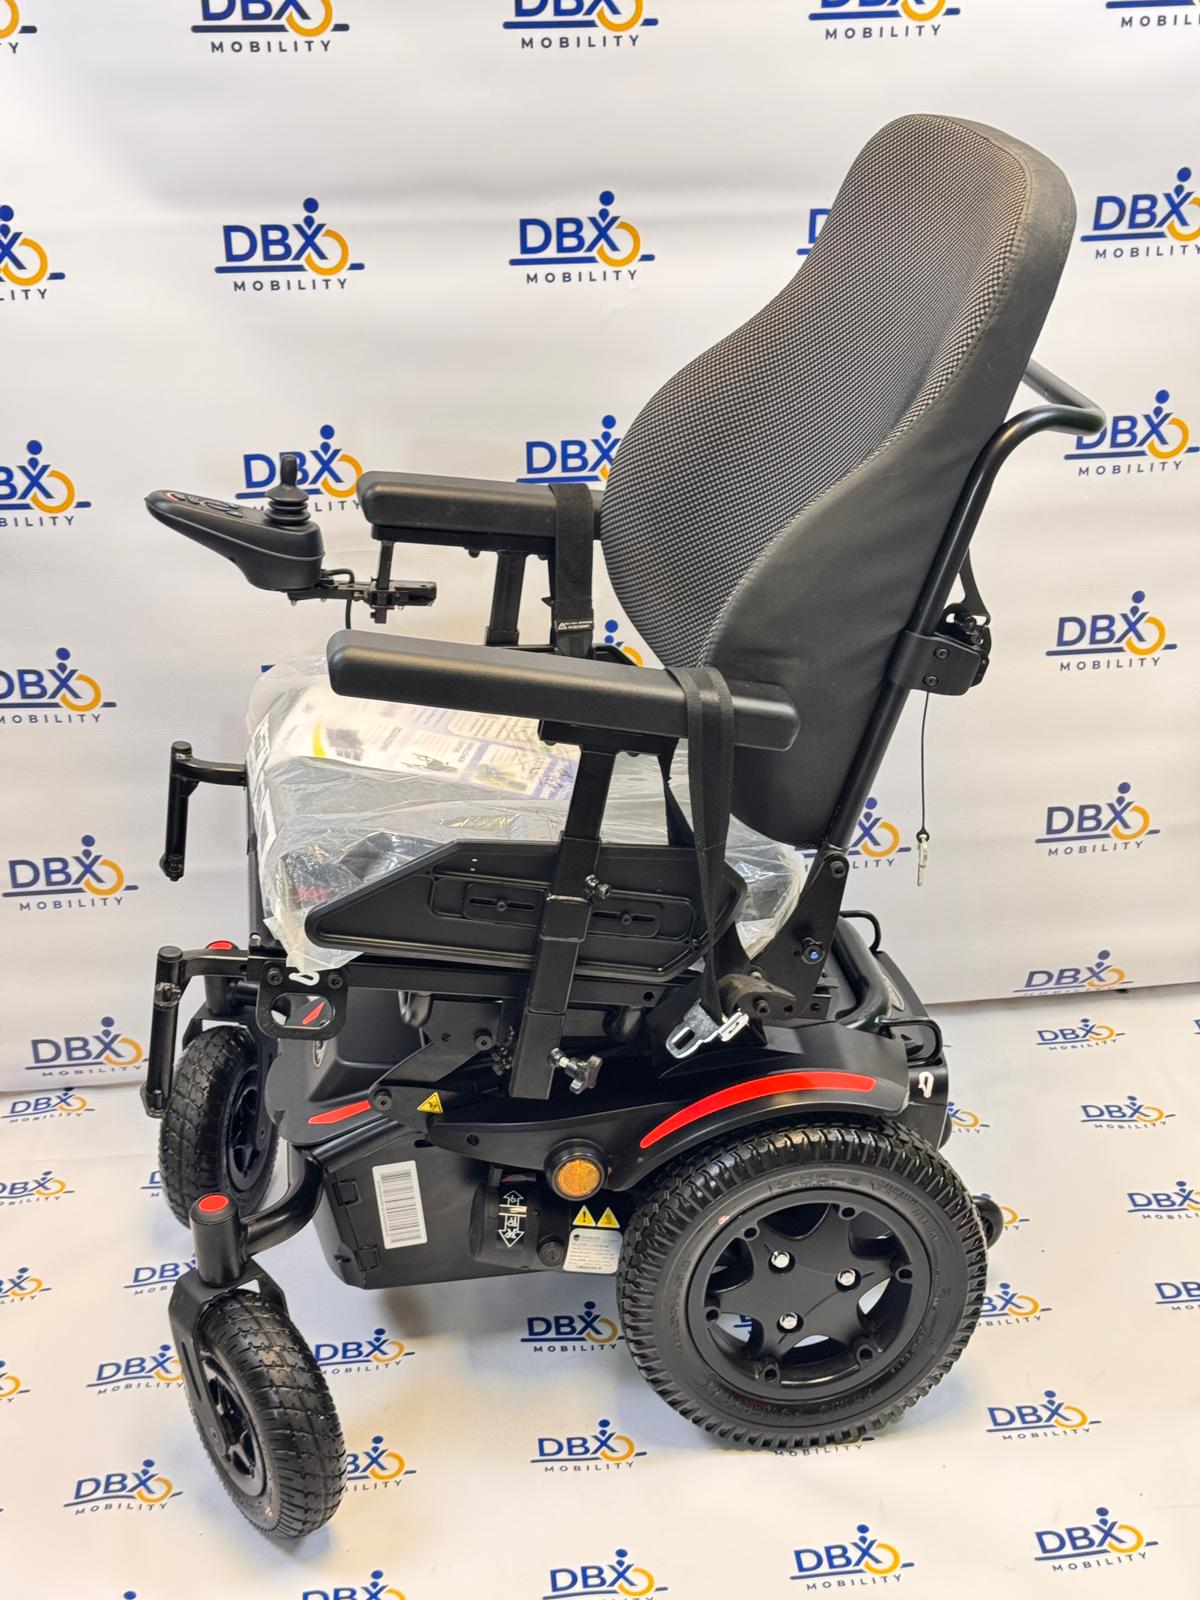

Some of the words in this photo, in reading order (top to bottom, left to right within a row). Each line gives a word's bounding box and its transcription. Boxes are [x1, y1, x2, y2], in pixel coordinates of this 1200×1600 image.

[1121, 14, 1200, 28] MOBIL
[521, 35, 639, 49] MOBILITY
[825, 25, 941, 40] MOBILITY
[211, 40, 330, 53] MOBILITY
[1093, 192, 1194, 231] DBX
[223, 224, 328, 263] DBX
[519, 216, 620, 255] DBX
[233, 278, 348, 292] MOBILITY
[526, 270, 638, 284] MOBILITY
[1078, 460, 1182, 476] MOBILITY
[0, 515, 74, 528] BILITY
[1056, 612, 1146, 647] DBX
[1060, 657, 1160, 672] MOBILITY
[1046, 801, 1140, 835] DBX
[1048, 840, 1144, 856] MOBILITY
[9, 855, 105, 889] DBX
[20, 897, 124, 911] MOBILITY
[1024, 965, 1112, 988] DBX
[1037, 1025, 1101, 1041] DBX
[31, 1033, 121, 1064] DBX
[42, 1065, 142, 1077] MOBILITY
[10, 1092, 75, 1114] DBX
[1081, 1103, 1150, 1120] DBX
[0, 1178, 54, 1196] BX
[1127, 1188, 1200, 1208] DBX
[1142, 1212, 1200, 1221] MOBILI
[1155, 1281, 1200, 1300] DB
[980, 1292, 1021, 1313] BX
[527, 1313, 607, 1337] DBX
[314, 1338, 391, 1362] DBX
[533, 1343, 617, 1352] MOBILITY
[96, 1354, 176, 1381] DBX
[97, 1382, 183, 1395] MOBILITY
[987, 1400, 1071, 1427] DBX
[1001, 1429, 1089, 1440] MOBILITY
[538, 1433, 619, 1457] DBX
[346, 1448, 388, 1474] BX
[545, 1461, 634, 1472] MOBILITY
[74, 1473, 157, 1500] DBX
[75, 1502, 167, 1515] MOBILITY
[1035, 1521, 1126, 1555] DBX
[793, 1540, 882, 1572] DBX
[1051, 1552, 1147, 1571] MOBILITY
[549, 1563, 637, 1592] DBX
[806, 1575, 901, 1591] MOBILITY
